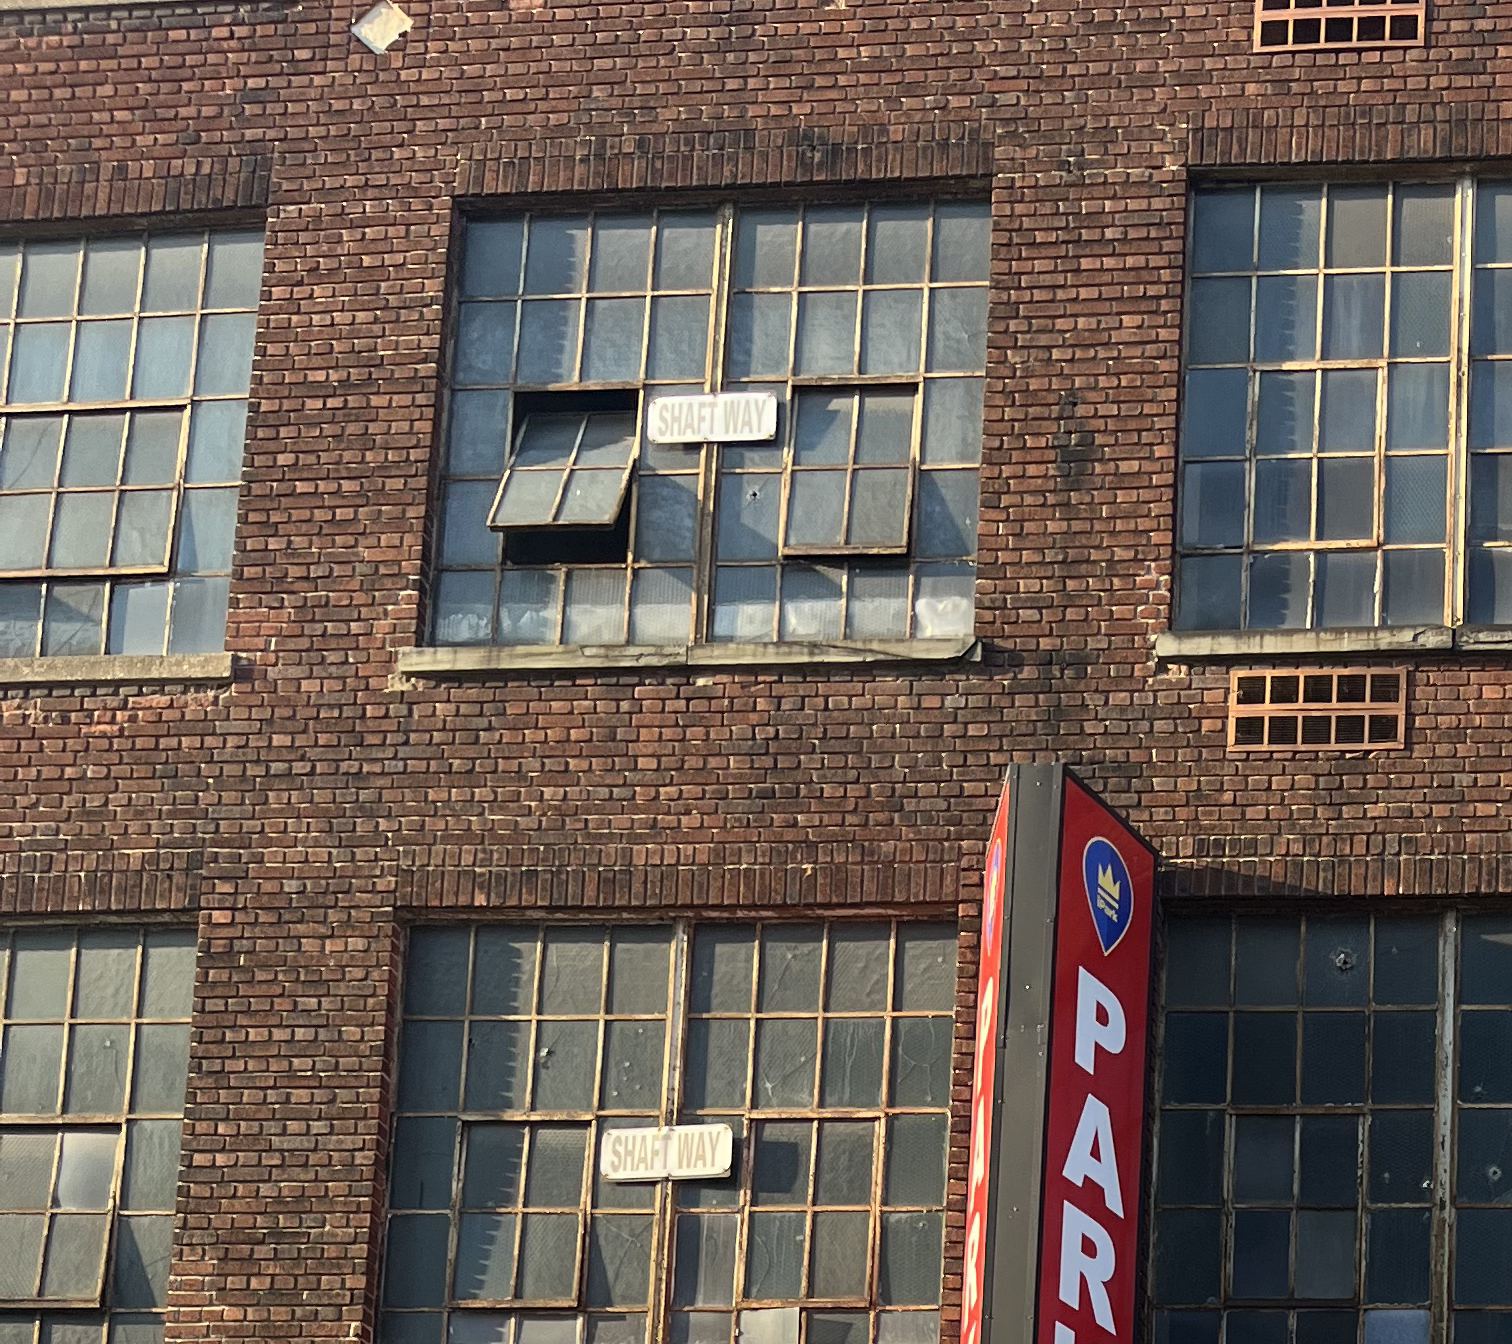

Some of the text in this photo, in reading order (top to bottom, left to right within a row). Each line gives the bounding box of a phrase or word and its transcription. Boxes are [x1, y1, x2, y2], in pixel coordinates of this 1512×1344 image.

[658, 399, 767, 437] SHAFT WAY
[610, 1131, 721, 1173] SHAFT WAY
